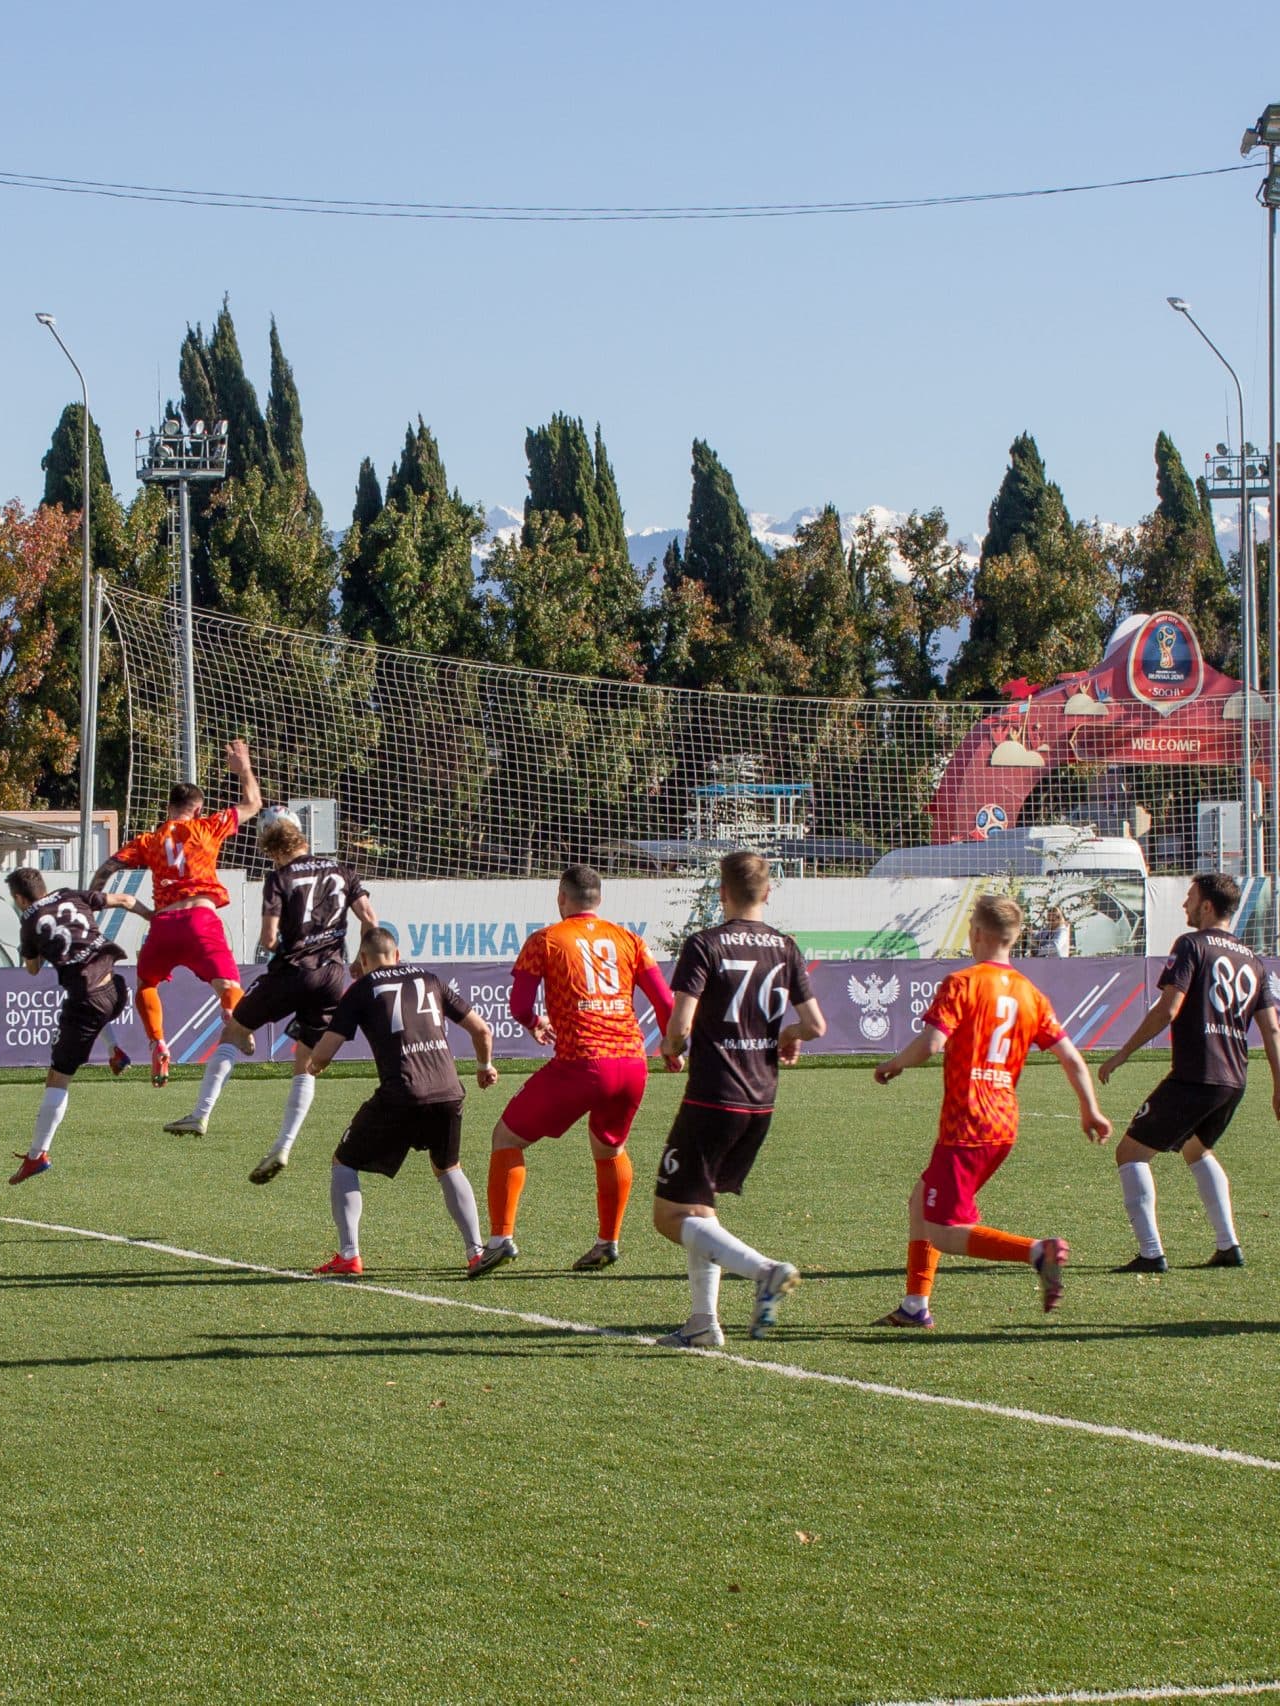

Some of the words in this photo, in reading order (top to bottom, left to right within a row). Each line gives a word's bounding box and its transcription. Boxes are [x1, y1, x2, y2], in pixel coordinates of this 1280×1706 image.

[1152, 687, 1180, 697] SOCHI
[1131, 738, 1201, 752] WELCOME!
[291, 873, 346, 927] 73
[35, 902, 90, 956] 33
[373, 978, 441, 1034] 74
[720, 959, 789, 1023] 76
[1209, 956, 1257, 1018] 89
[484, 1021, 524, 1038] ОЮЗ
[987, 995, 1019, 1065] 2
[663, 1148, 680, 1175] 6
